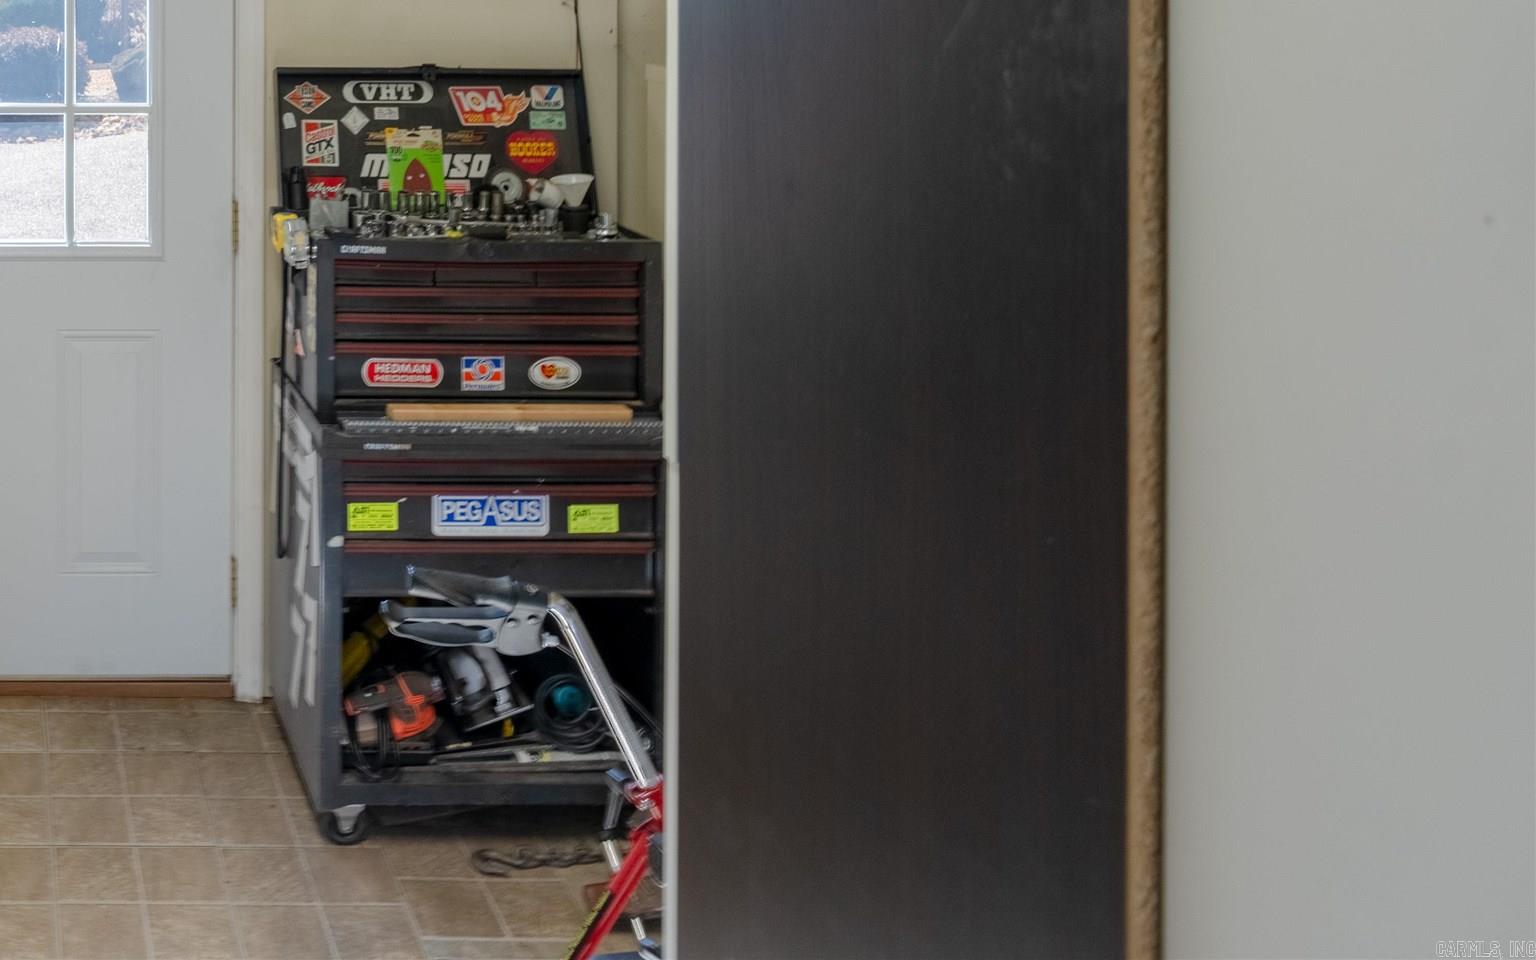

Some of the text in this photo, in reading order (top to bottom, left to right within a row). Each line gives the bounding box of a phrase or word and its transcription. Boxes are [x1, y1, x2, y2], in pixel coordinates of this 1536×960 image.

[359, 83, 415, 101] VHT
[455, 89, 504, 113] 104
[305, 136, 335, 155] GTX
[374, 362, 433, 374] HEDMAN
[442, 496, 542, 527] PEGASUS
